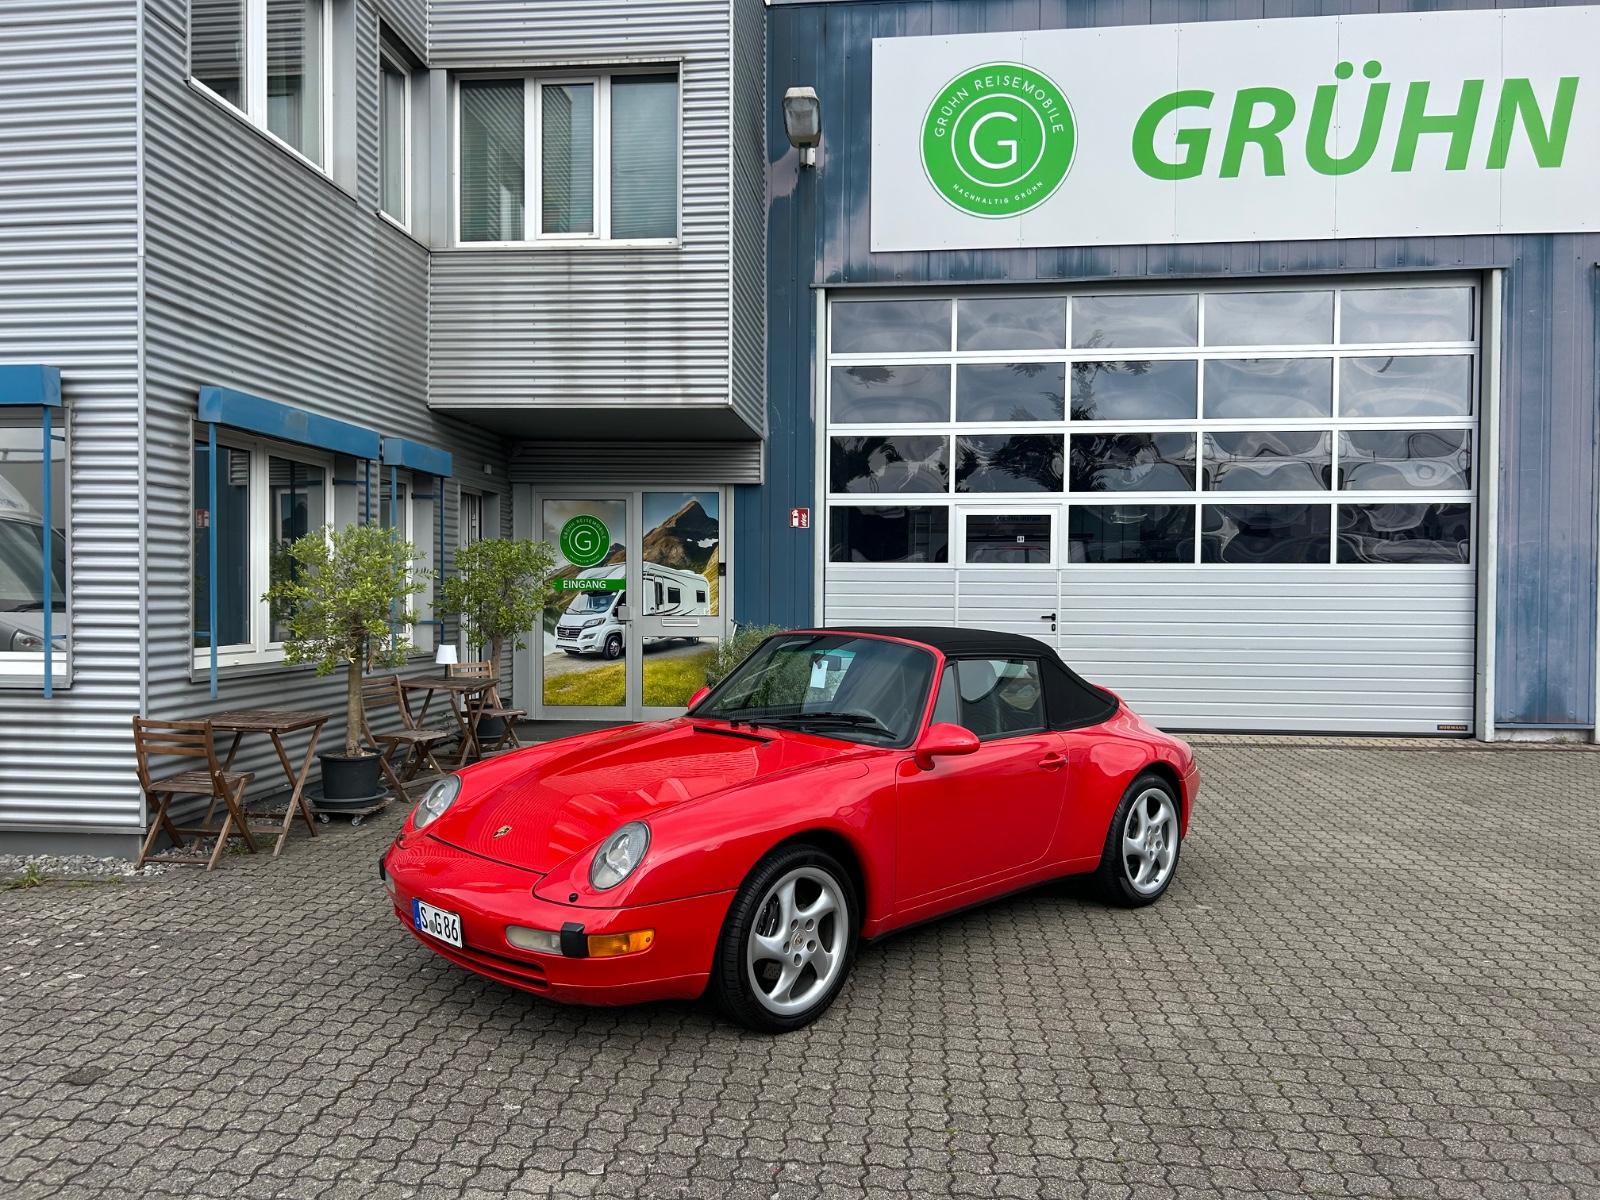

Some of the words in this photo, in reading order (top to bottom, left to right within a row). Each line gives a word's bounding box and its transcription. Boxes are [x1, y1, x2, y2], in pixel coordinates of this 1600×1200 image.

[934, 87, 969, 138] GRÜHN
[974, 75, 1064, 134] REISEMOBILE
[1132, 60, 1580, 181] GRÜHN
[968, 111, 1018, 170] G
[952, 183, 1009, 205] NACHHALTIG
[1014, 180, 1044, 201] GRÜHN
[574, 530, 592, 551] G
[562, 580, 607, 589] EINGANG
